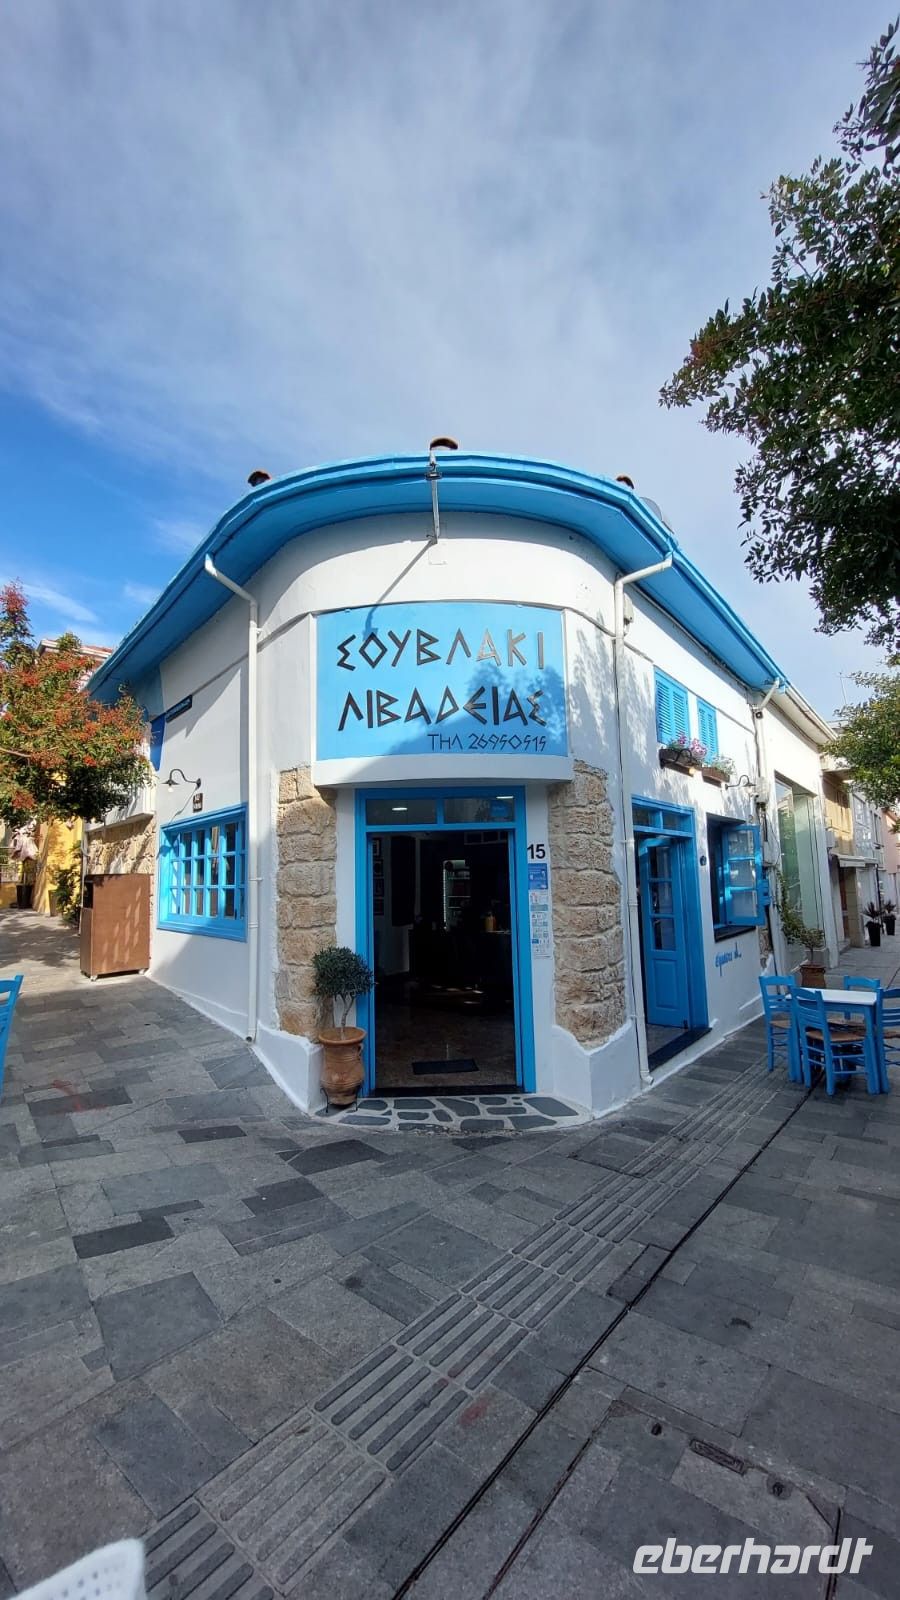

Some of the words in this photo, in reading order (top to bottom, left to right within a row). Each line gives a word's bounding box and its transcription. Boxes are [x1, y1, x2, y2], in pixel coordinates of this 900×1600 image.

[337, 627, 545, 671] ΣΟΥΒΛΑΚΙ
[338, 685, 547, 731] ΛΙΒΑΔΕΙΑΣ
[427, 733, 463, 751] ΤΗΛ
[527, 843, 546, 860] 15
